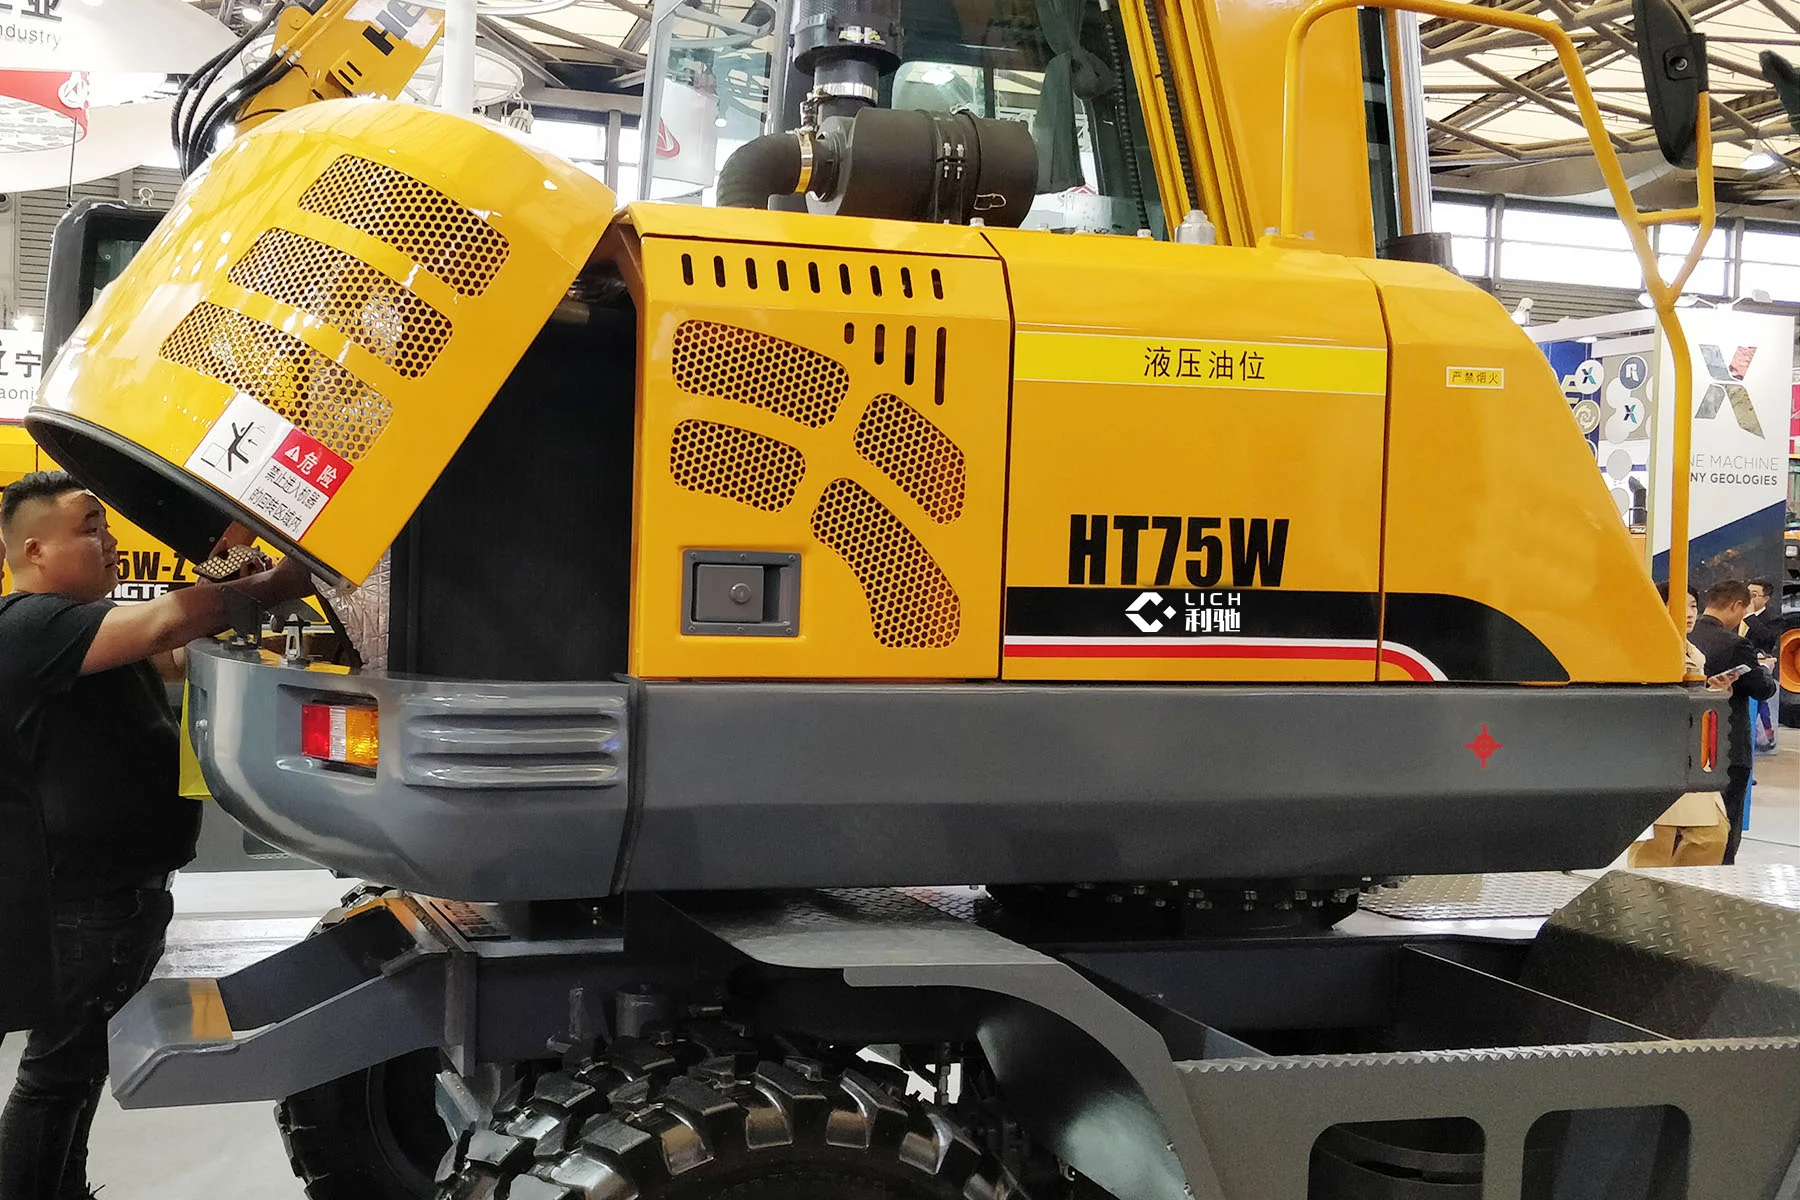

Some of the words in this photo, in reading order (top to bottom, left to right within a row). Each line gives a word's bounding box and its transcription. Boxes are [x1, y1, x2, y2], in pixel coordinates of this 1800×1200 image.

[1144, 346, 1265, 381] 液压油位
[1452, 371, 1499, 384] 严禁烟火
[1710, 456, 1779, 471] MACHINE
[1690, 472, 1706, 482] NY
[1710, 473, 1778, 486] GEOLOGIES
[1068, 514, 1290, 587] HT75W
[117, 551, 186, 581] 5W-Z
[1185, 592, 1241, 606] LICH
[1185, 608, 1241, 632] 利驰
